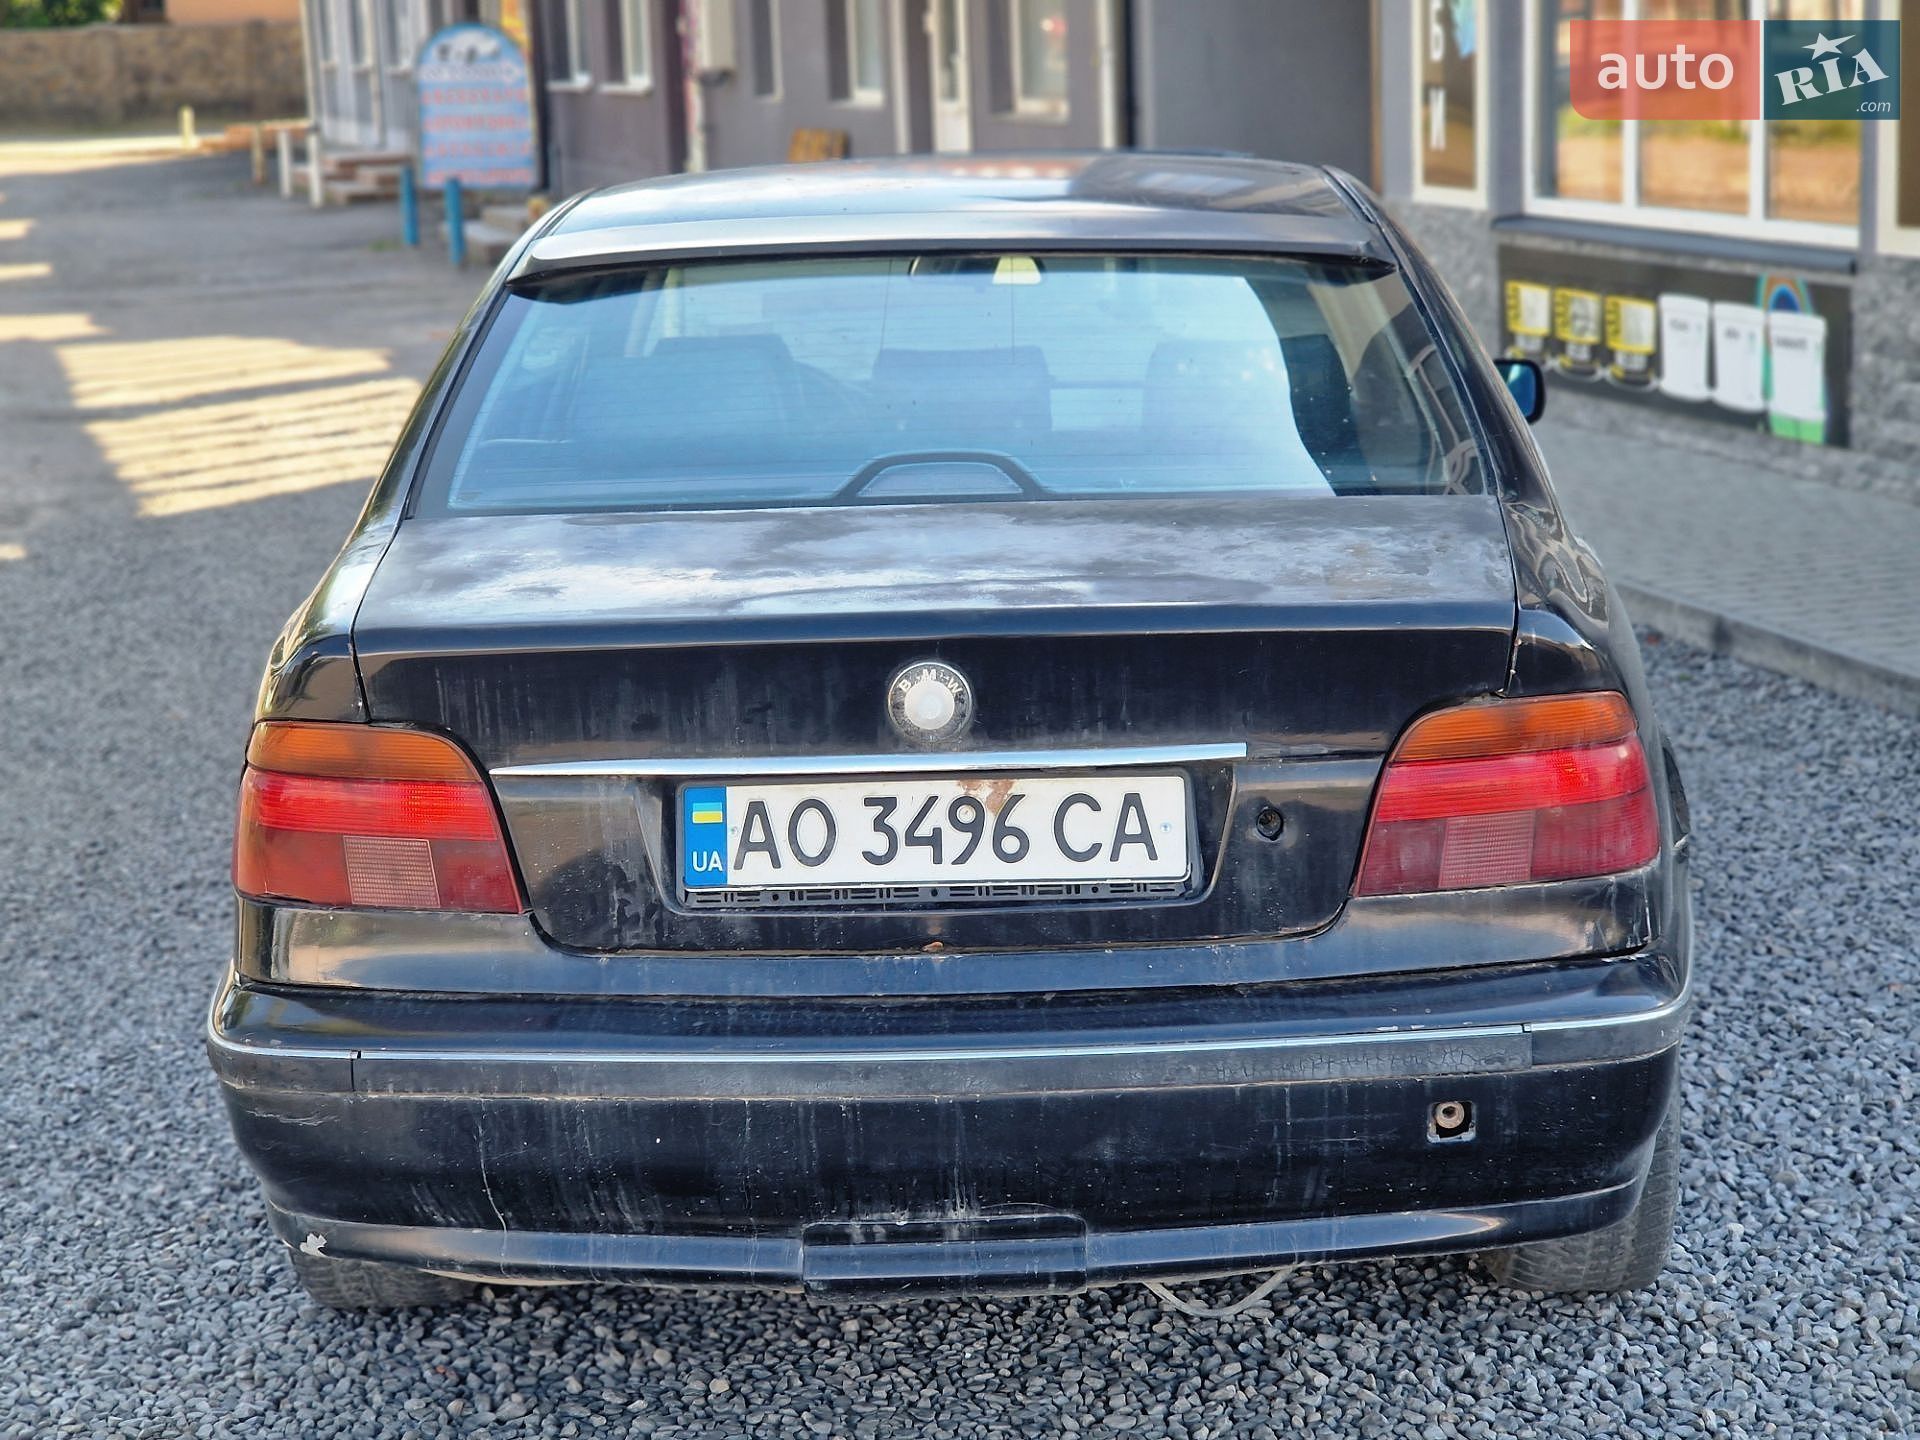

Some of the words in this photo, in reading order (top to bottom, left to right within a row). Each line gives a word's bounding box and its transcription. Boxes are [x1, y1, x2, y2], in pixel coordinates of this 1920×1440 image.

[733, 798, 838, 871] AO
[861, 794, 1030, 867] 3496
[1053, 792, 1158, 863] CA
[692, 851, 723, 872] UA
